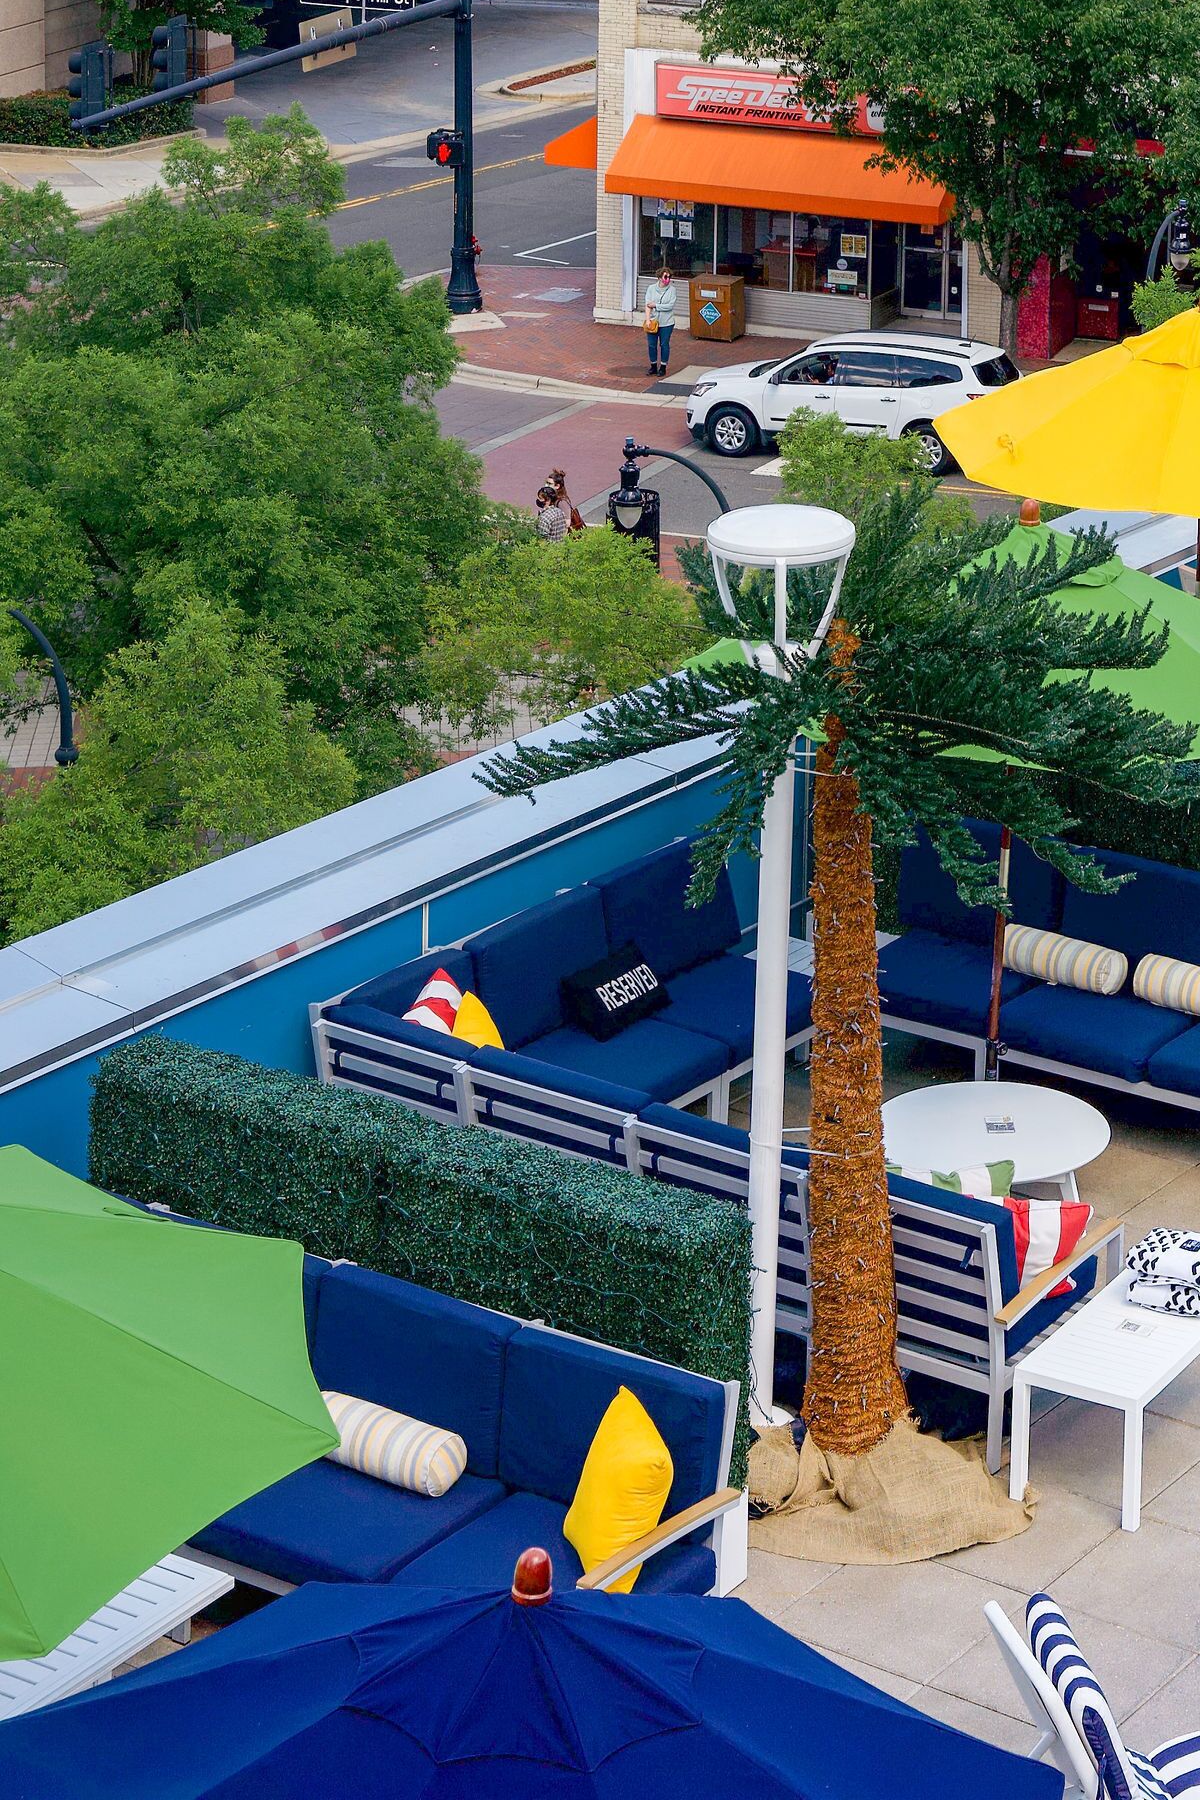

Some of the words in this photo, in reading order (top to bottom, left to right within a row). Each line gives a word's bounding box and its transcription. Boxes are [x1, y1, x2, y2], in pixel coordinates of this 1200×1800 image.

[695, 103, 745, 117] INSTANT
[744, 108, 803, 122] PRINTING
[595, 962, 659, 1012] RESERVED
